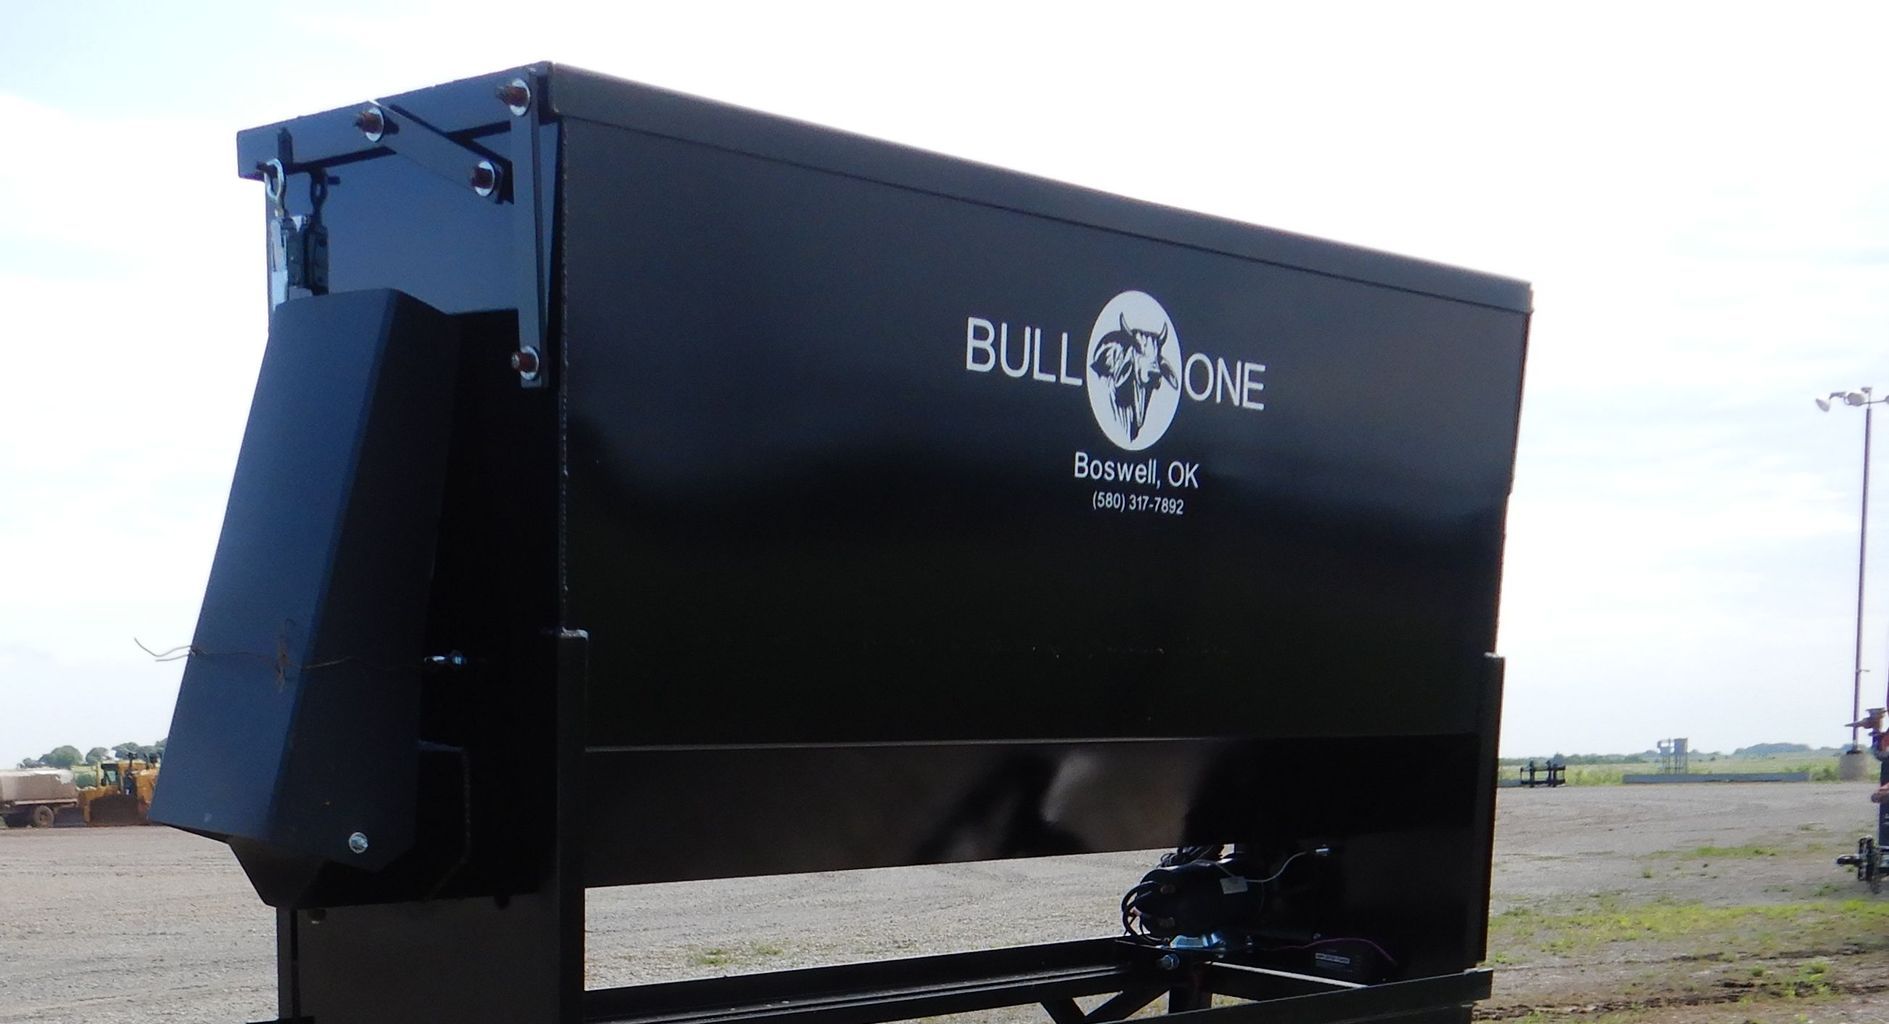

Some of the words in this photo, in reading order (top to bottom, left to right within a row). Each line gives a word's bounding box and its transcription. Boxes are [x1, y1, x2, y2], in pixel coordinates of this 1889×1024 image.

[965, 317, 1083, 386] BULL
[1183, 352, 1267, 411] ONE
[1073, 451, 1161, 489] Boswell,
[1168, 460, 1200, 489] OK
[1092, 490, 1126, 513] (580)
[1128, 493, 1184, 515] 317-7892
